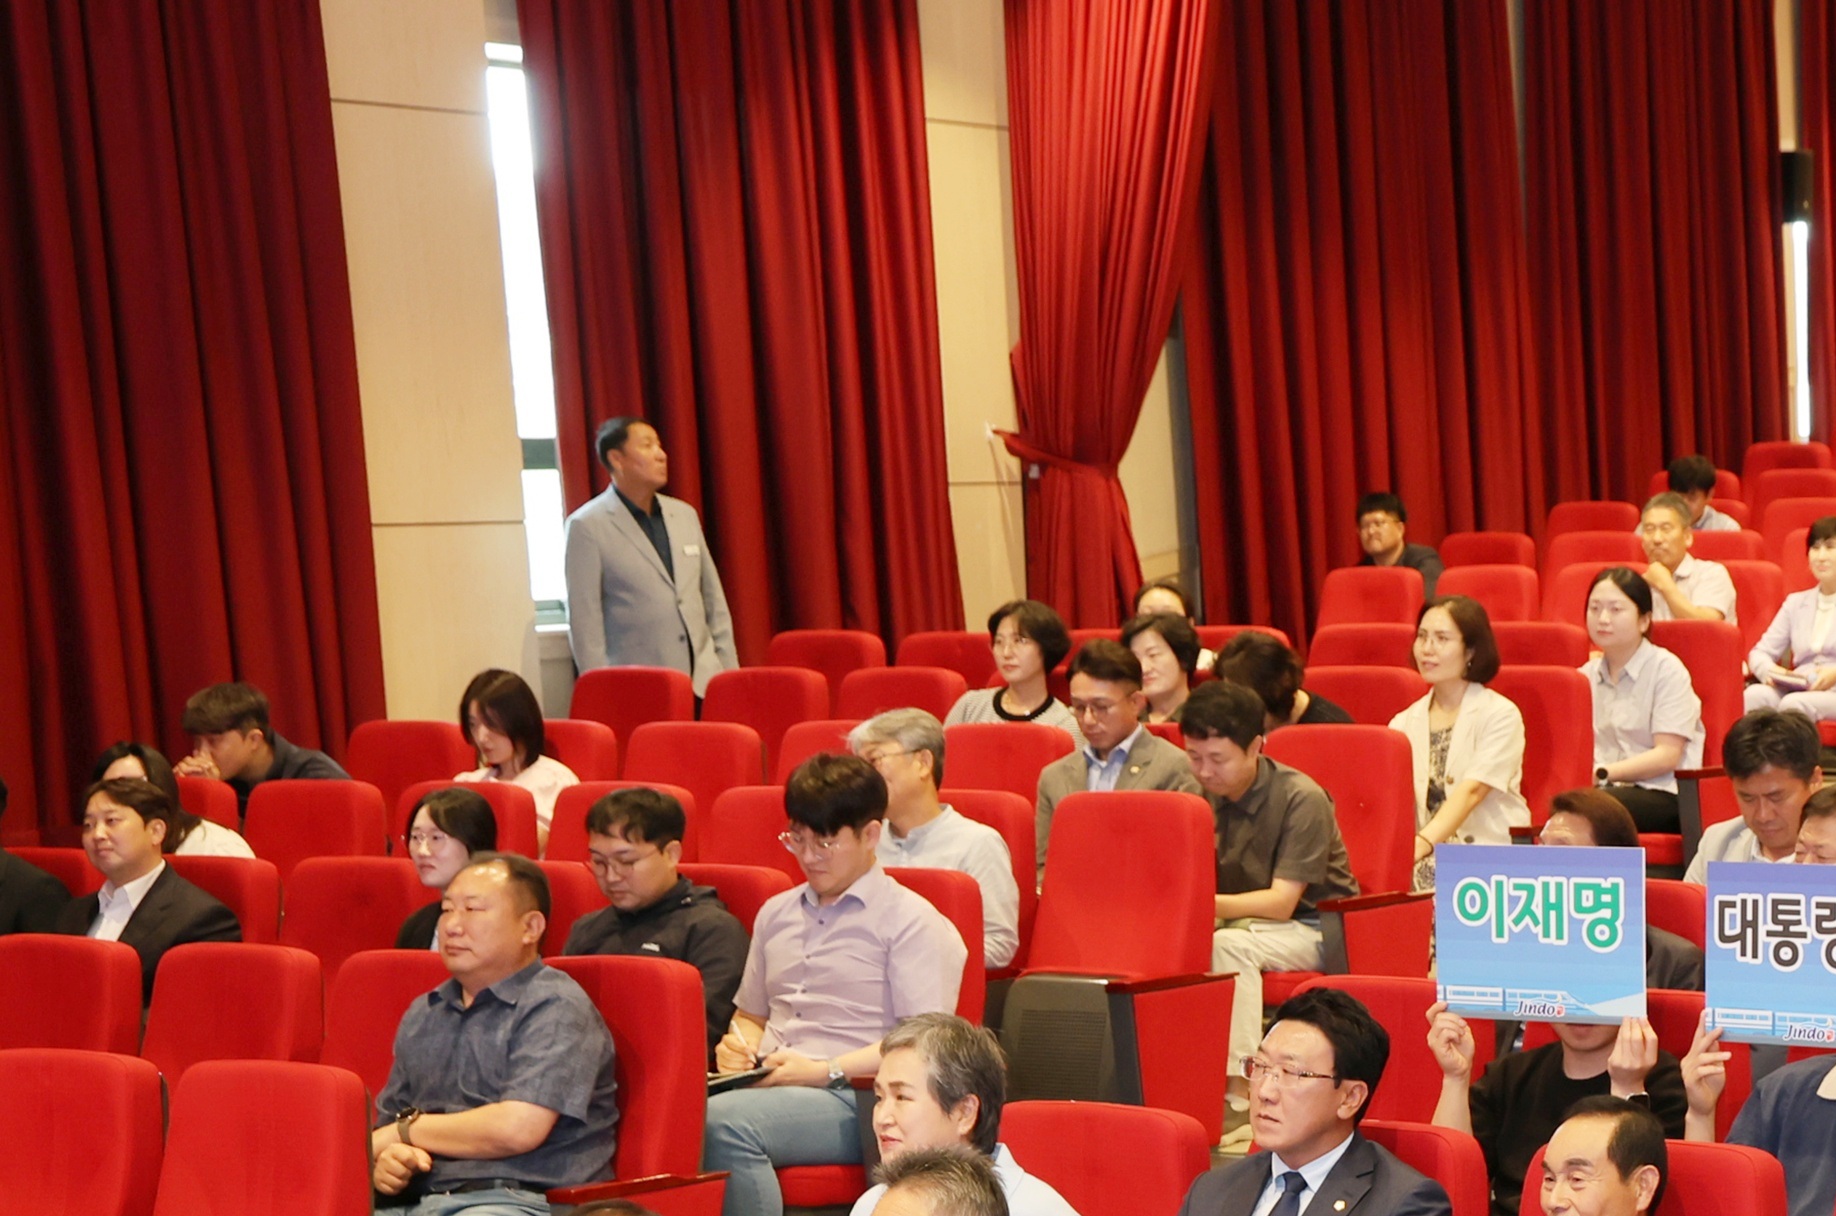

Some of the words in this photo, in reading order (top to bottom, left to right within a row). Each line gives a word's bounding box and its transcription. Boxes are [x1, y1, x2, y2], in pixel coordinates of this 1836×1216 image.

[1455, 876, 1623, 951] 이재명
[1514, 1000, 1556, 1017] Jindo
[1784, 1025, 1826, 1042] Jindo
